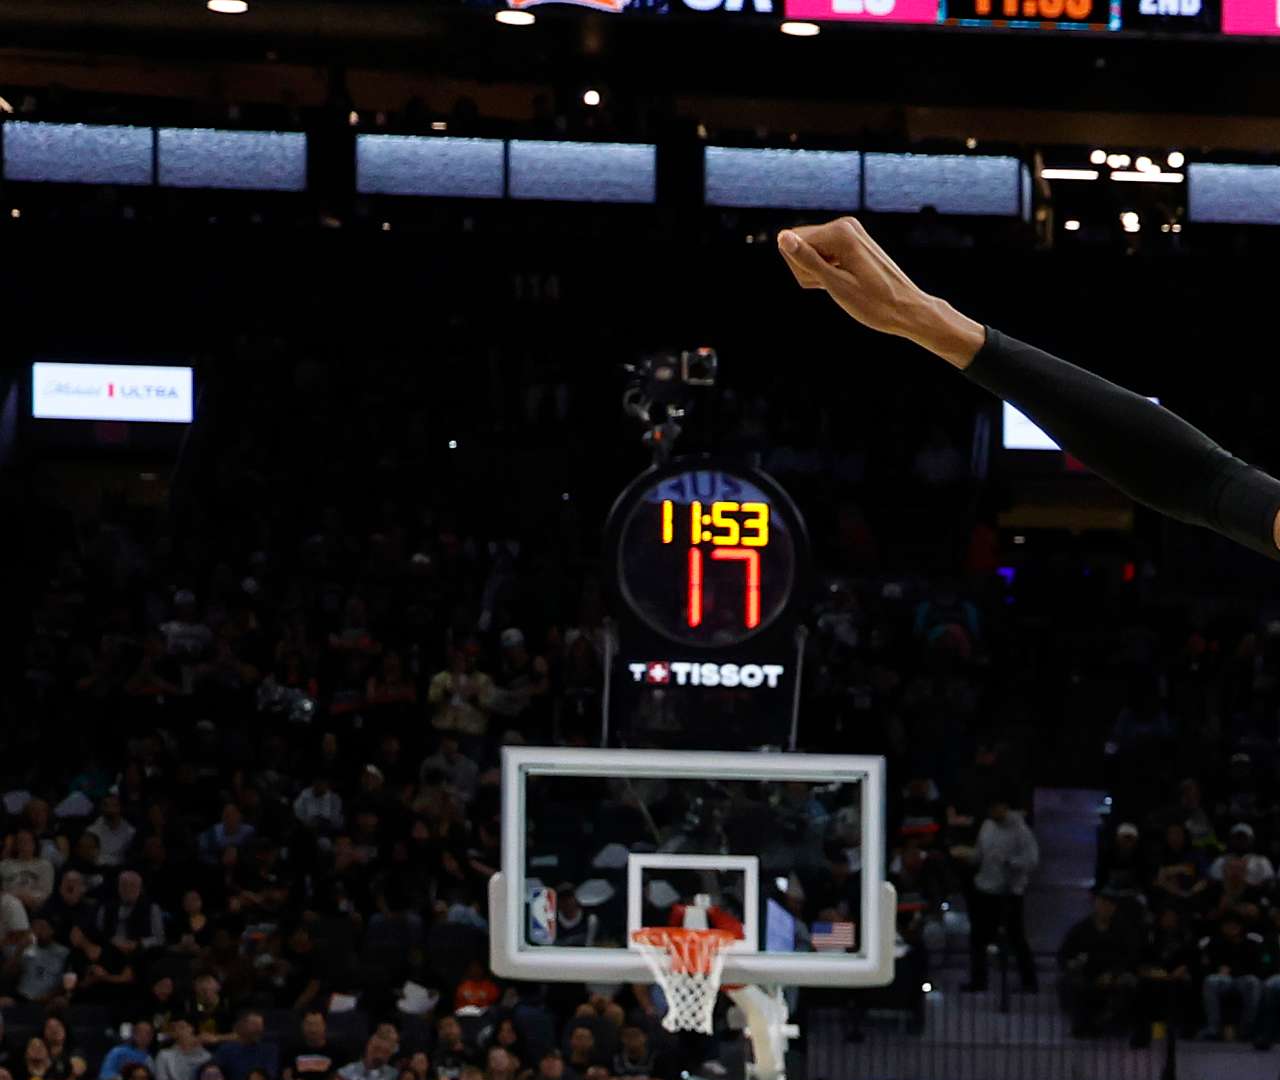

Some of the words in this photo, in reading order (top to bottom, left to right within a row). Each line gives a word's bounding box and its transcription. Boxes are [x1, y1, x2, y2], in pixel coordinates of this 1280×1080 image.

[662, 499, 770, 547] 11:53
[687, 547, 761, 629] 17
[670, 662, 784, 688] TISSOT
